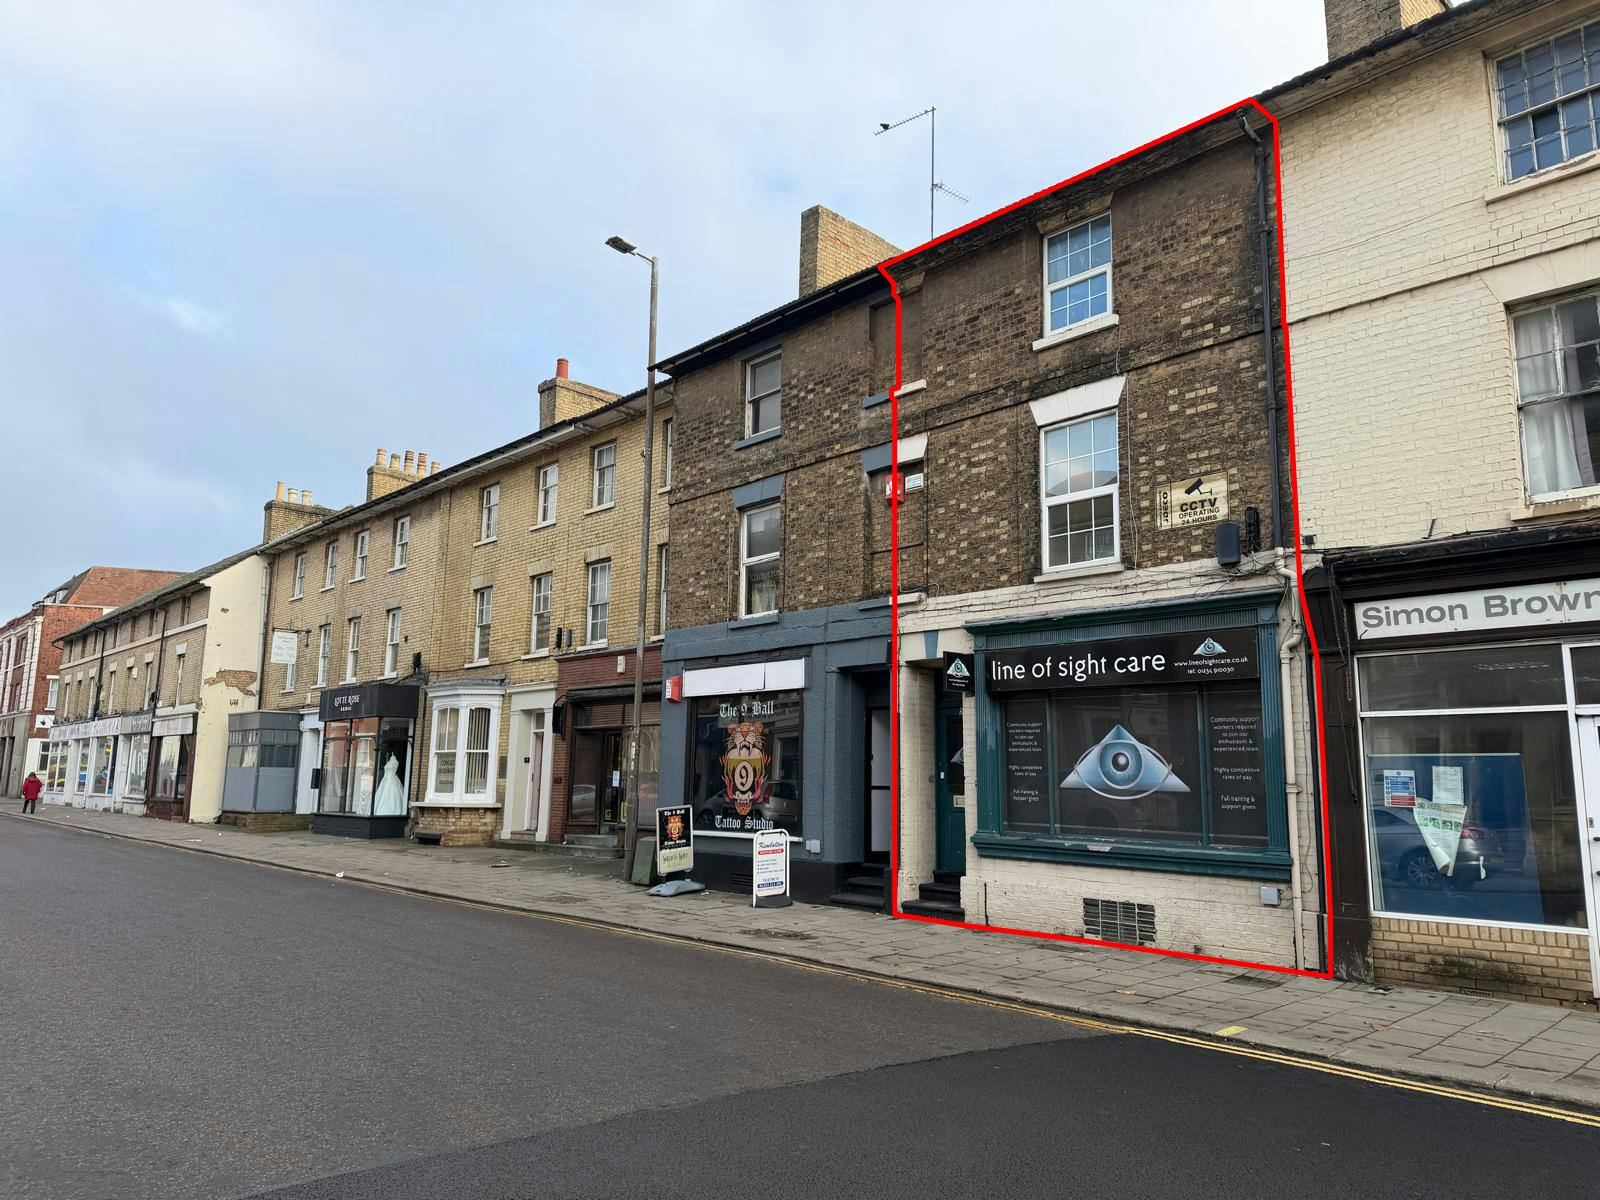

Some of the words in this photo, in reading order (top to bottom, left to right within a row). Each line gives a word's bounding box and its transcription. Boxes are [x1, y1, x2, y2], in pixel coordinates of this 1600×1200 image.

[1178, 506, 1220, 519] OPERATING
[1180, 497, 1217, 512] CCTV
[1192, 514, 1218, 524] HOURS
[1362, 603, 1468, 629] Simon
[992, 660, 1026, 681] line
[1032, 656, 1052, 678] of
[1058, 653, 1107, 682] sight
[1114, 654, 1166, 673] care
[719, 703, 738, 720] The
[741, 703, 748, 715] 9
[752, 700, 774, 717] Ball
[739, 765, 749, 788] 9
[714, 815, 741, 829] Tattoo
[744, 816, 774, 830] Studio
